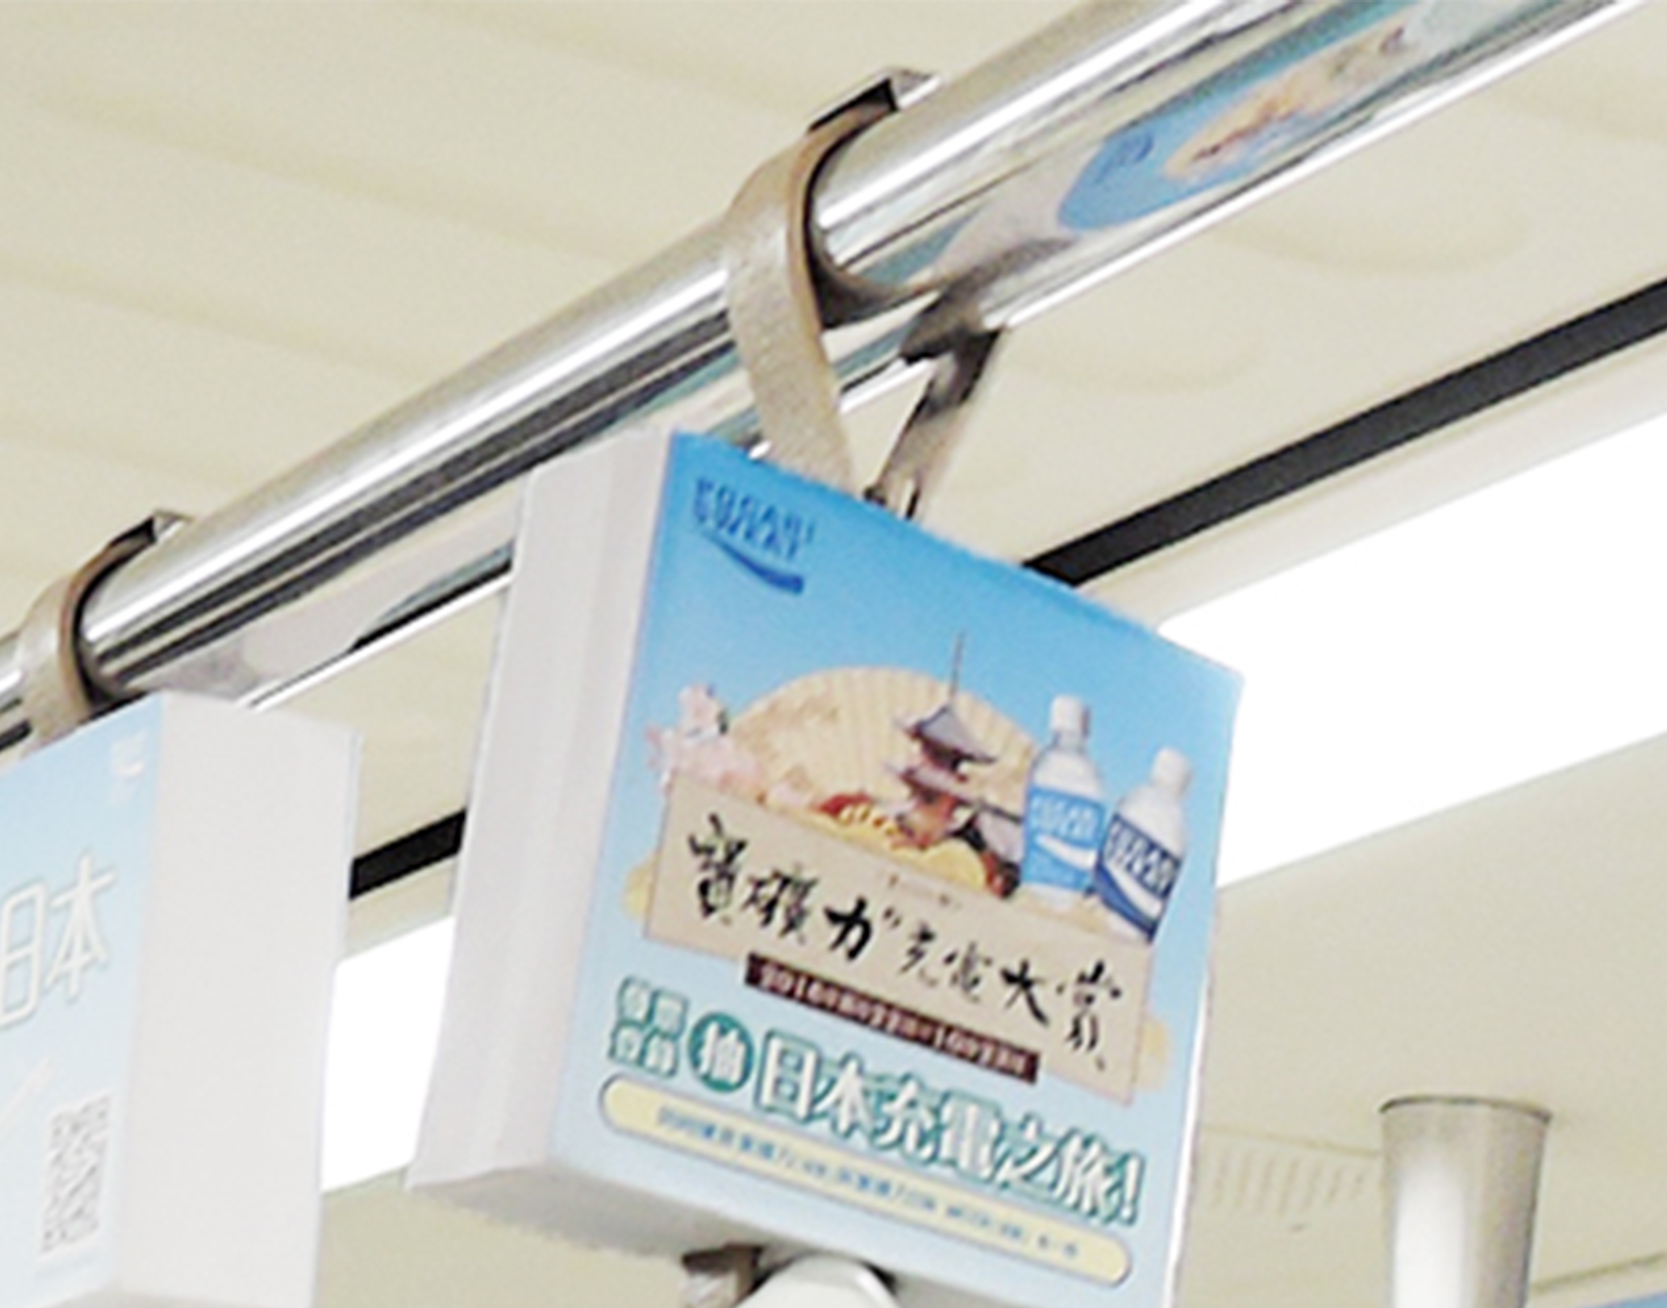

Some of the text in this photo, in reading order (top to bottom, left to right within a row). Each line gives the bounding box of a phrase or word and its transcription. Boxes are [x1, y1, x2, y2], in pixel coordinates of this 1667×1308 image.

[756, 1030, 1144, 1226] 日本充電之旅!
